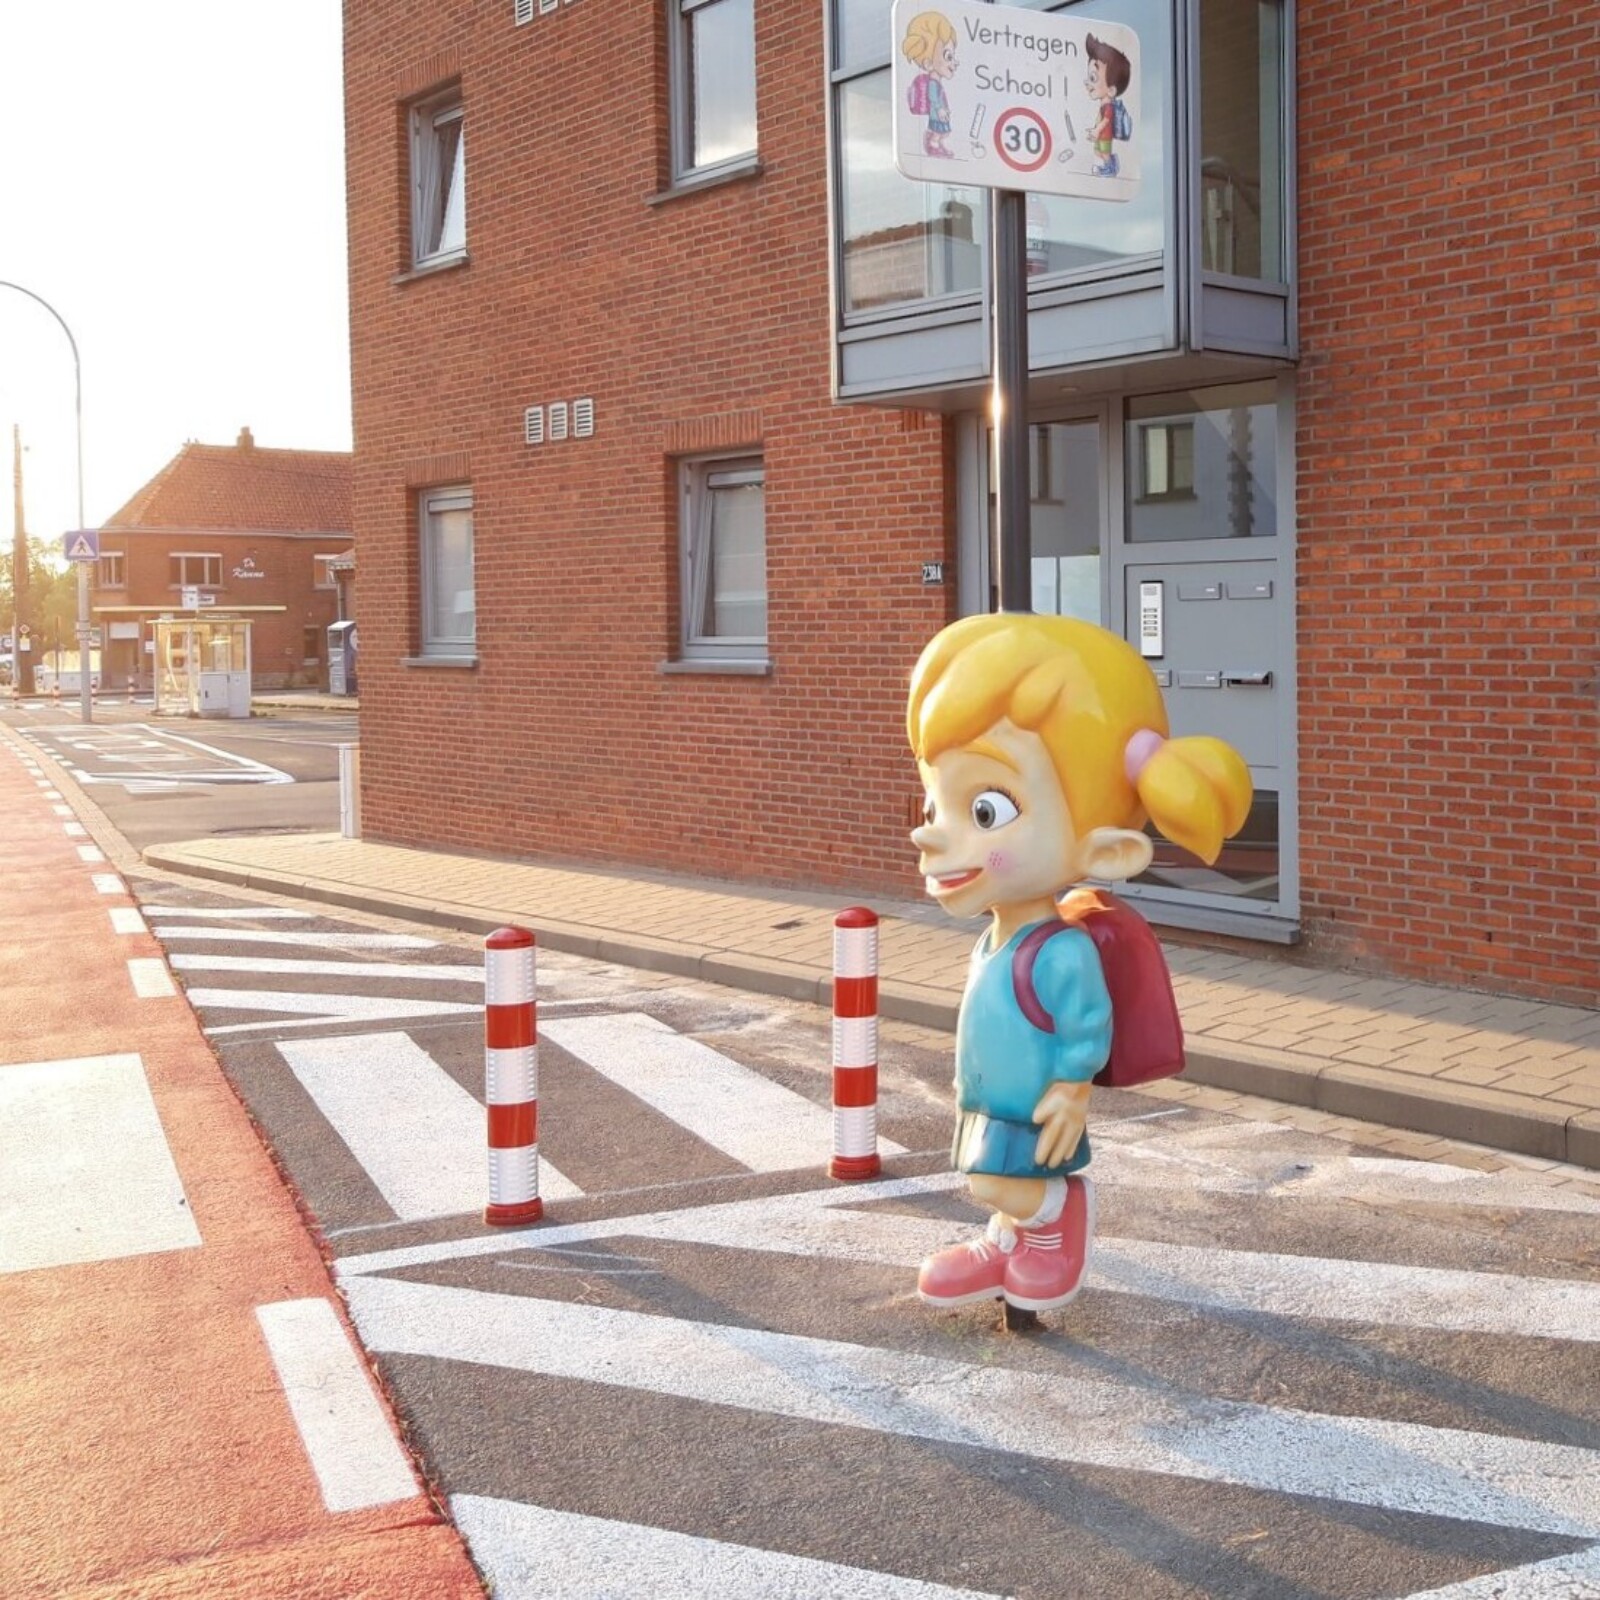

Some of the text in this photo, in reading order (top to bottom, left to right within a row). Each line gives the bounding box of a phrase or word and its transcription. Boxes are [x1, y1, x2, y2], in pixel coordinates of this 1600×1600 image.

[963, 16, 1078, 62] Vertragen
[974, 64, 1052, 99] School
[1004, 124, 1042, 155] 30
